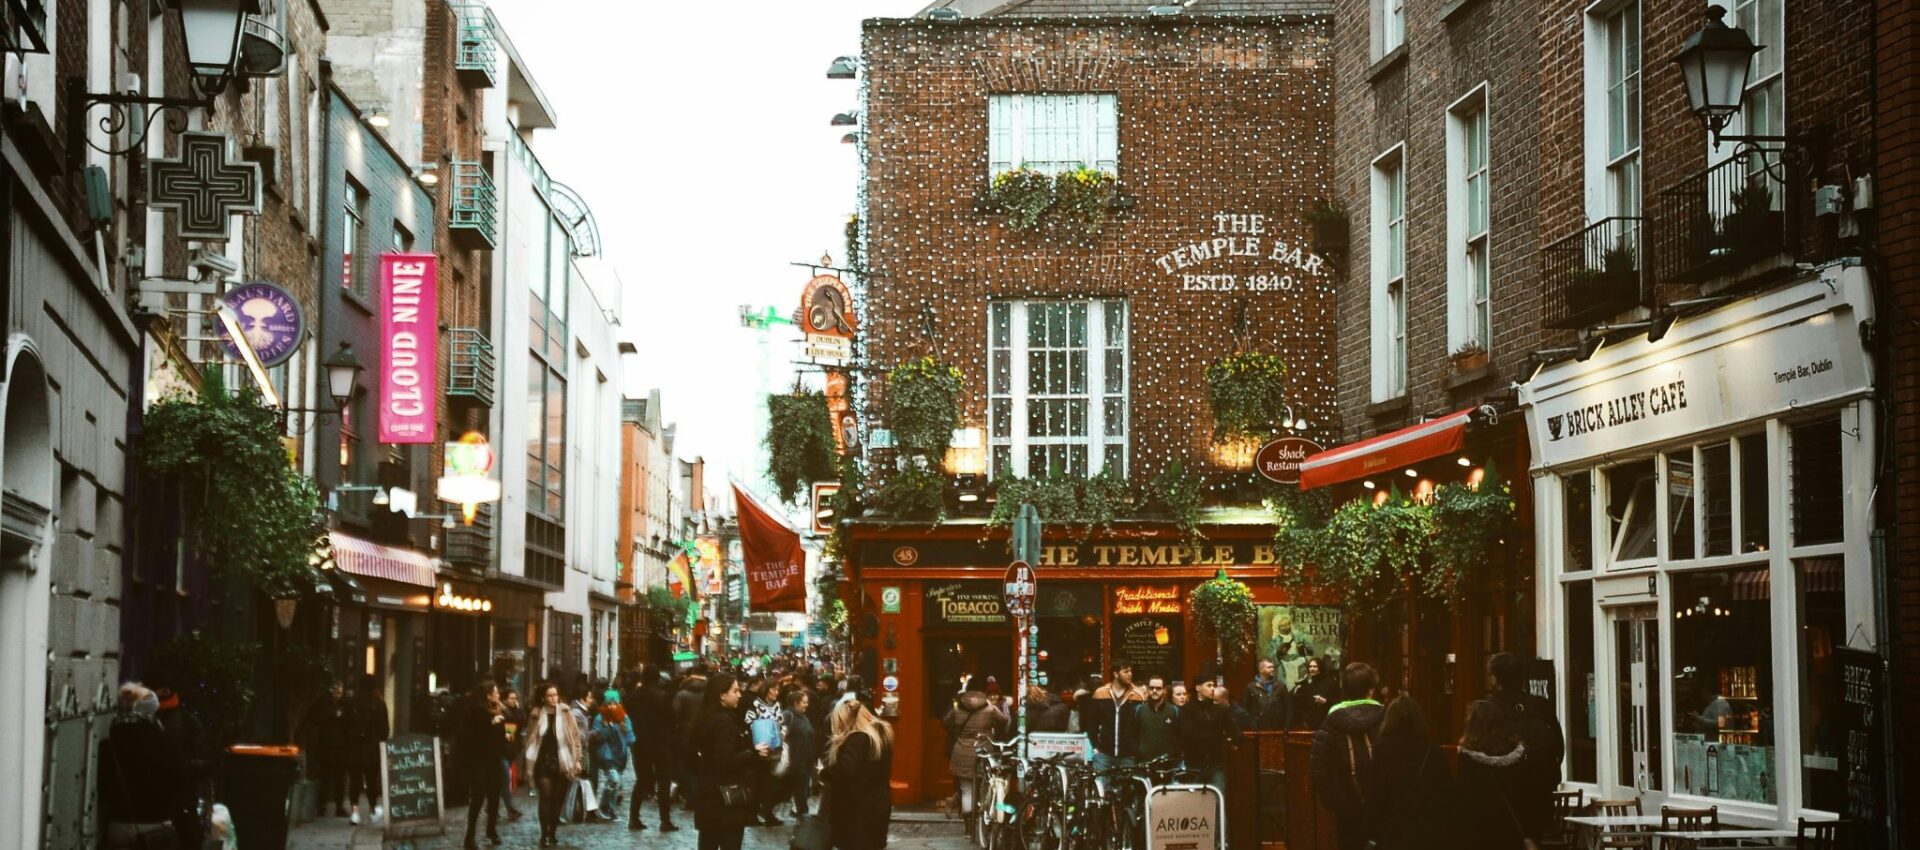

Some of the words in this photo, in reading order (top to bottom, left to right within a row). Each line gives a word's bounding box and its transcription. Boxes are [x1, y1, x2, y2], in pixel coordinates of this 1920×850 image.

[1213, 213, 1265, 234] THE
[1155, 236, 1261, 276] TEMPLE
[1271, 240, 1324, 276] BAR
[392, 261, 426, 323] NINE
[1247, 274, 1293, 291] 1840
[227, 286, 264, 309] EAL'S
[268, 290, 296, 324] YARD
[391, 330, 425, 418] CLOUD
[1773, 367, 1797, 384] Temple
[1797, 365, 1811, 379] Bar,
[1811, 358, 1833, 375] Dublin
[1566, 402, 1606, 437] BRICK
[1608, 391, 1647, 427] ALLEY
[1649, 371, 1688, 415] CAFÉ
[765, 560, 785, 570] THE
[897, 549, 913, 562] 48
[1037, 545, 1079, 566] HE
[1093, 545, 1236, 566] TEMPLE
[750, 564, 799, 582] TEMPLE
[765, 578, 788, 591] BAR
[1116, 587, 1178, 602] Traditional
[937, 597, 999, 619] TOBACCO
[1114, 602, 1143, 614] Irish
[1148, 601, 1180, 613] Music
[1309, 624, 1338, 636] BAR
